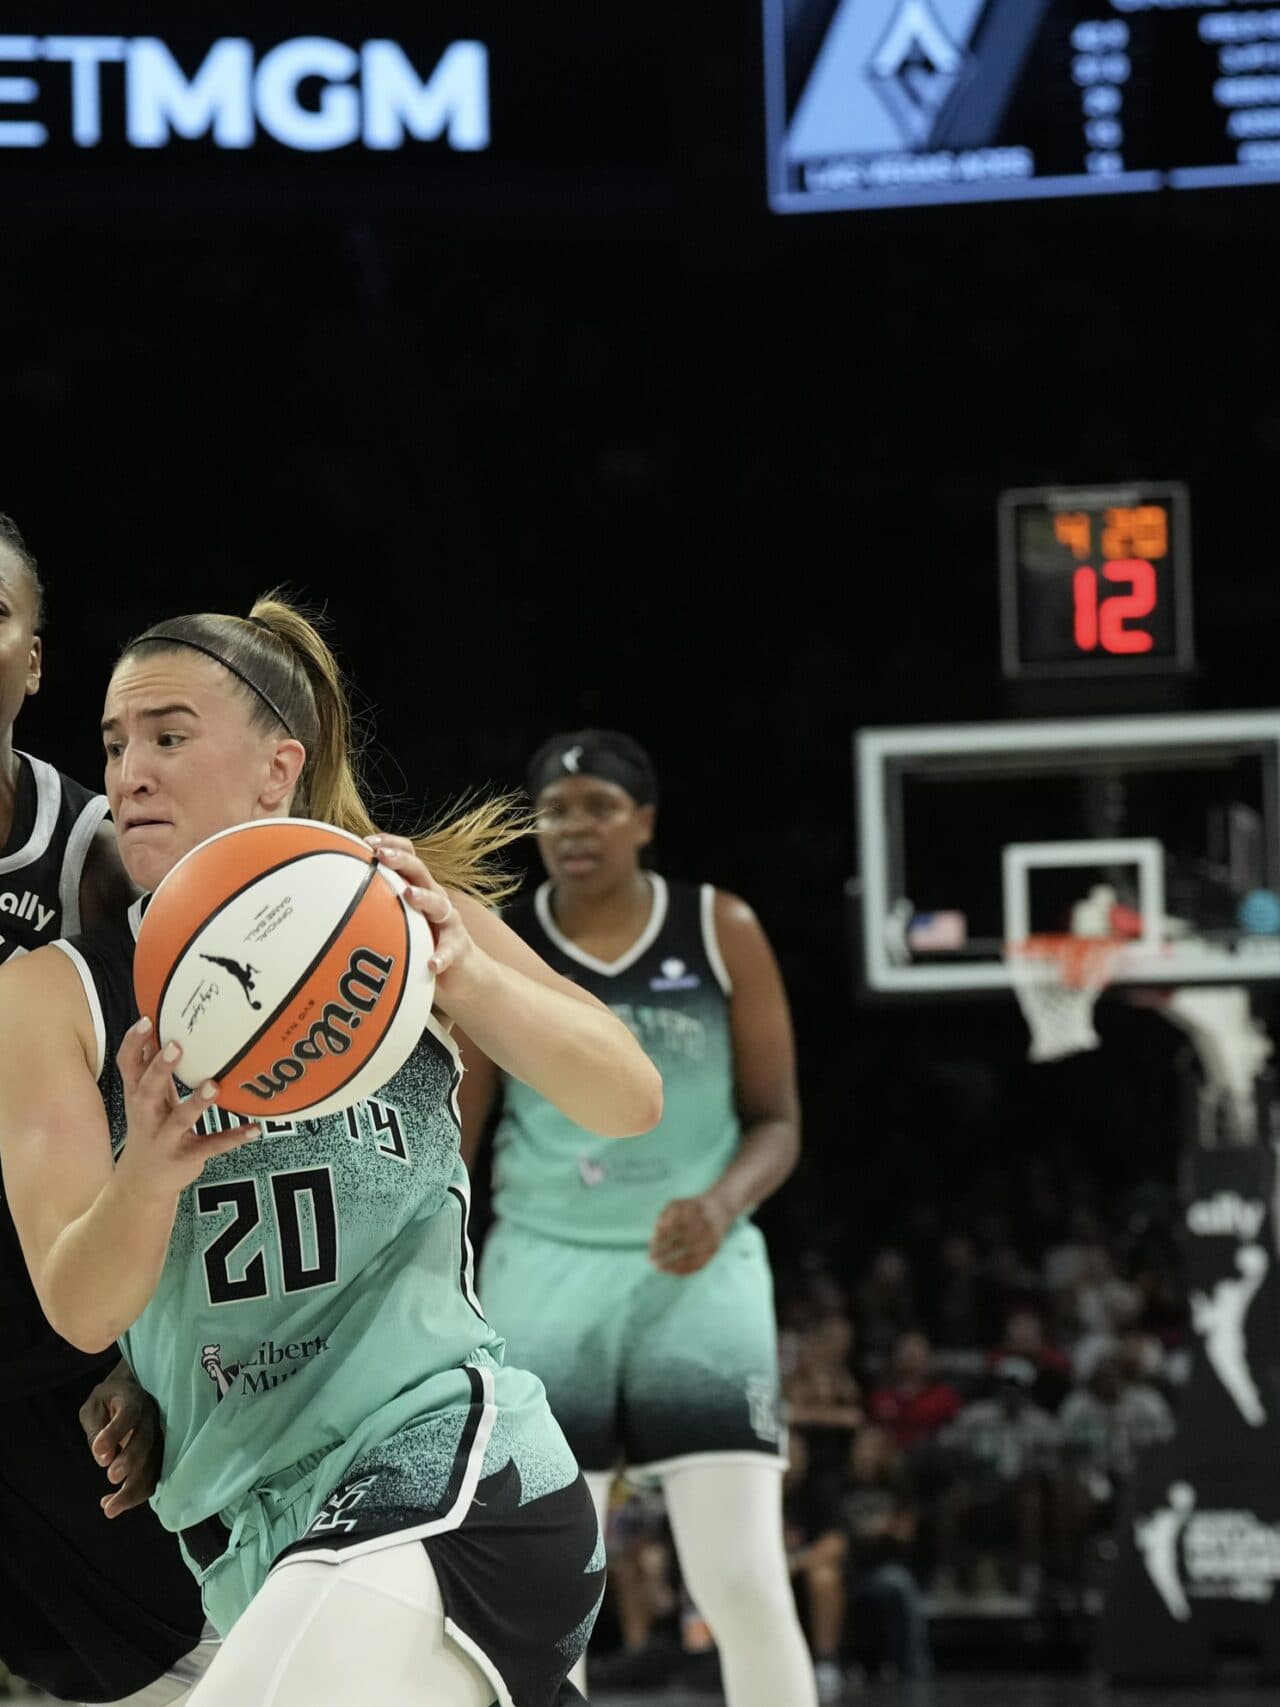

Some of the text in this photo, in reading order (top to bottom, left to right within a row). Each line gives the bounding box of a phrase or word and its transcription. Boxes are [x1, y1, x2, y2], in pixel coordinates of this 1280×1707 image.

[1073, 557, 1157, 655] 12
[238, 946, 394, 1100] Wilson
[196, 1165, 340, 1307] 20
